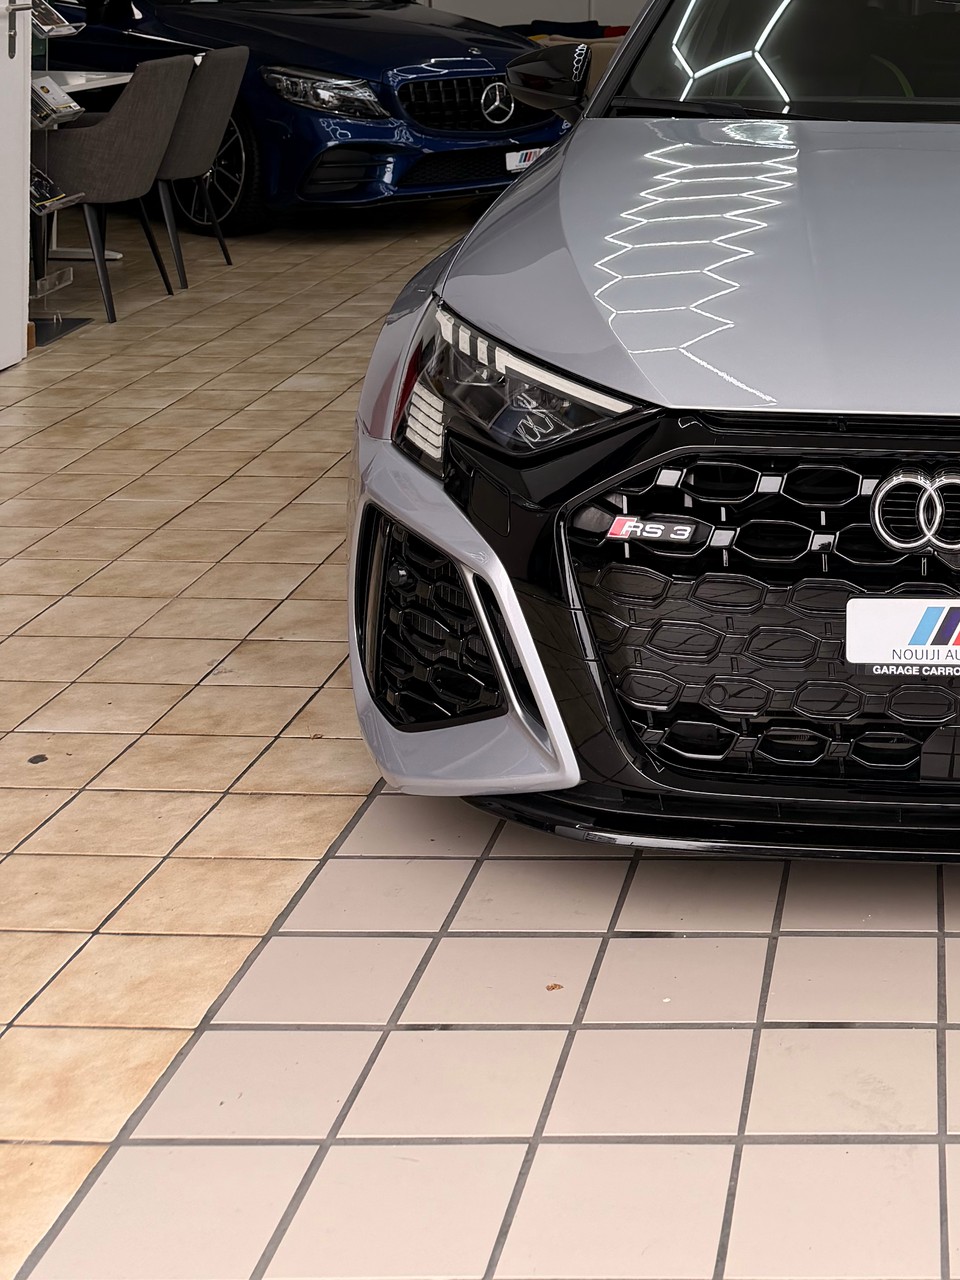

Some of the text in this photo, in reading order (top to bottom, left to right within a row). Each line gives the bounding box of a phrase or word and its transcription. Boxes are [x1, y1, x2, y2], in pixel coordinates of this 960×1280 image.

[621, 521, 692, 540] RS 3
[892, 649, 940, 661] NOUIJI
[872, 665, 920, 675] GARAGE
